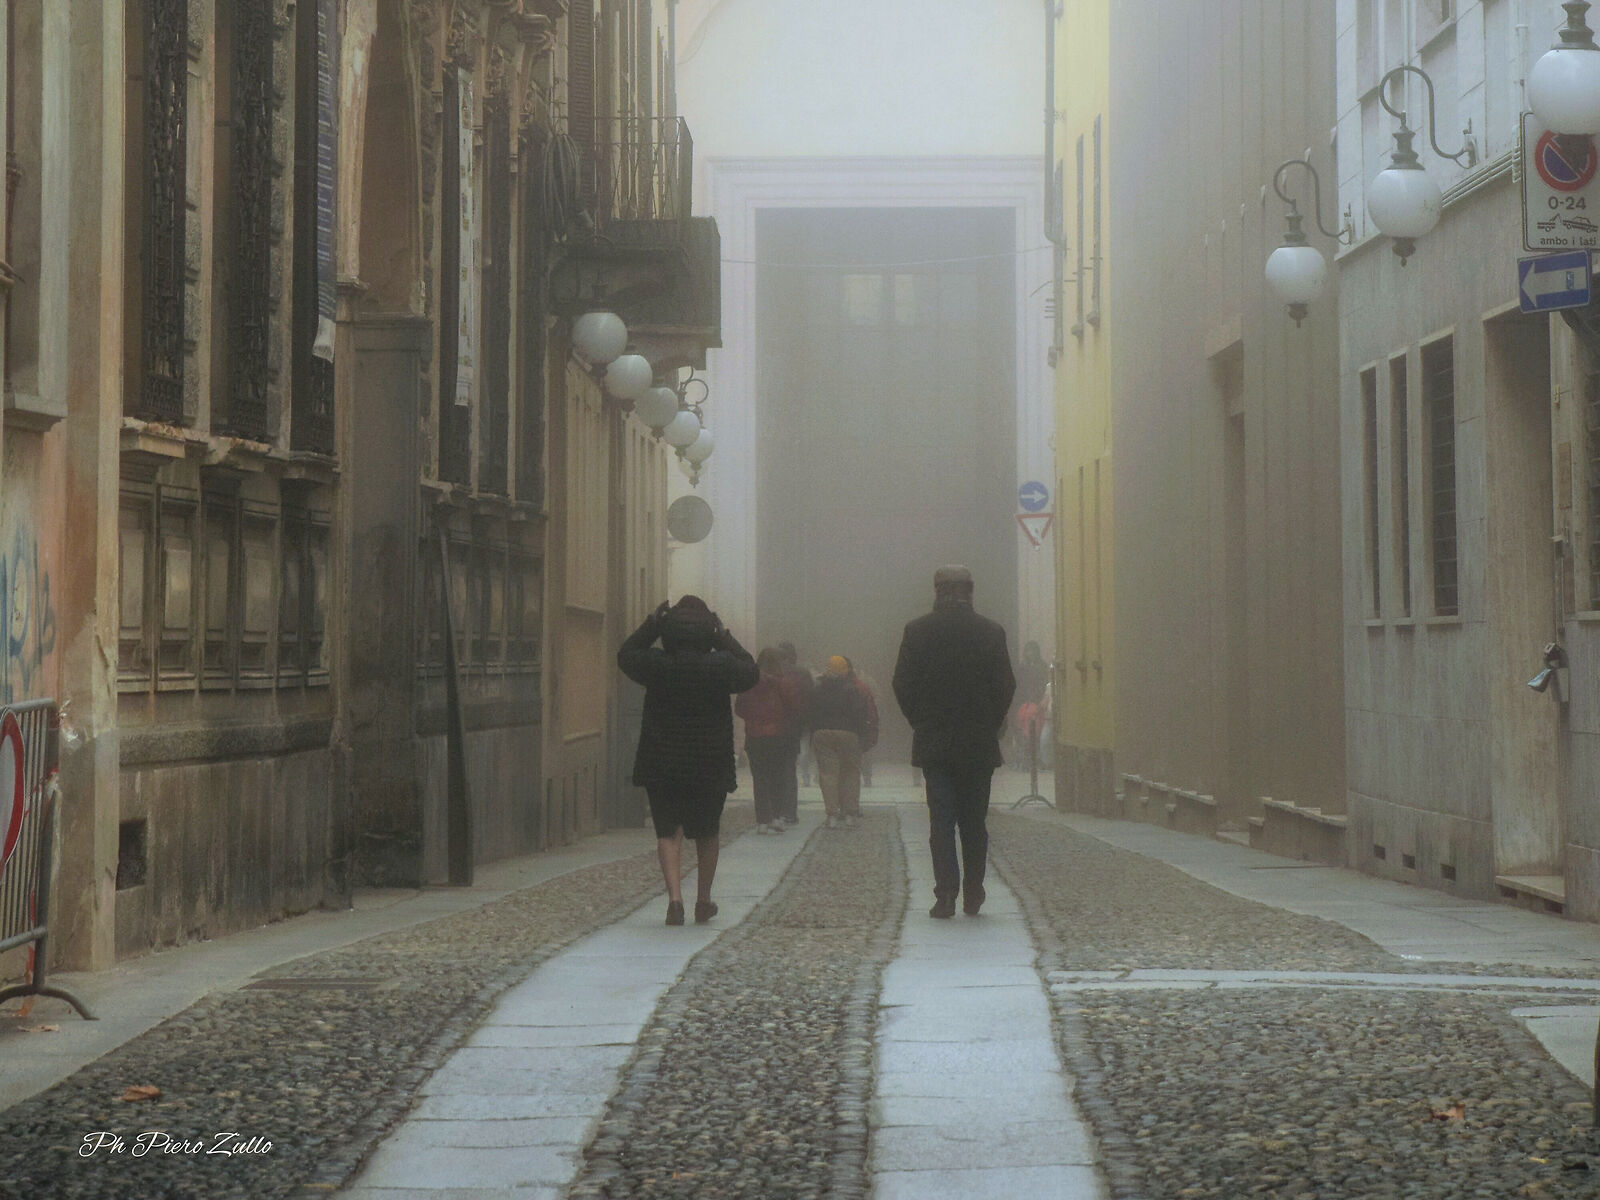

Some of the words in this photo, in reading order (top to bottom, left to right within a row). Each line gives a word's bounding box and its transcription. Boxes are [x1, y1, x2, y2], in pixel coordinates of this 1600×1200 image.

[1548, 196, 1586, 210] 0-24
[1540, 235, 1568, 246] ambo
[1580, 236, 1597, 246] lati
